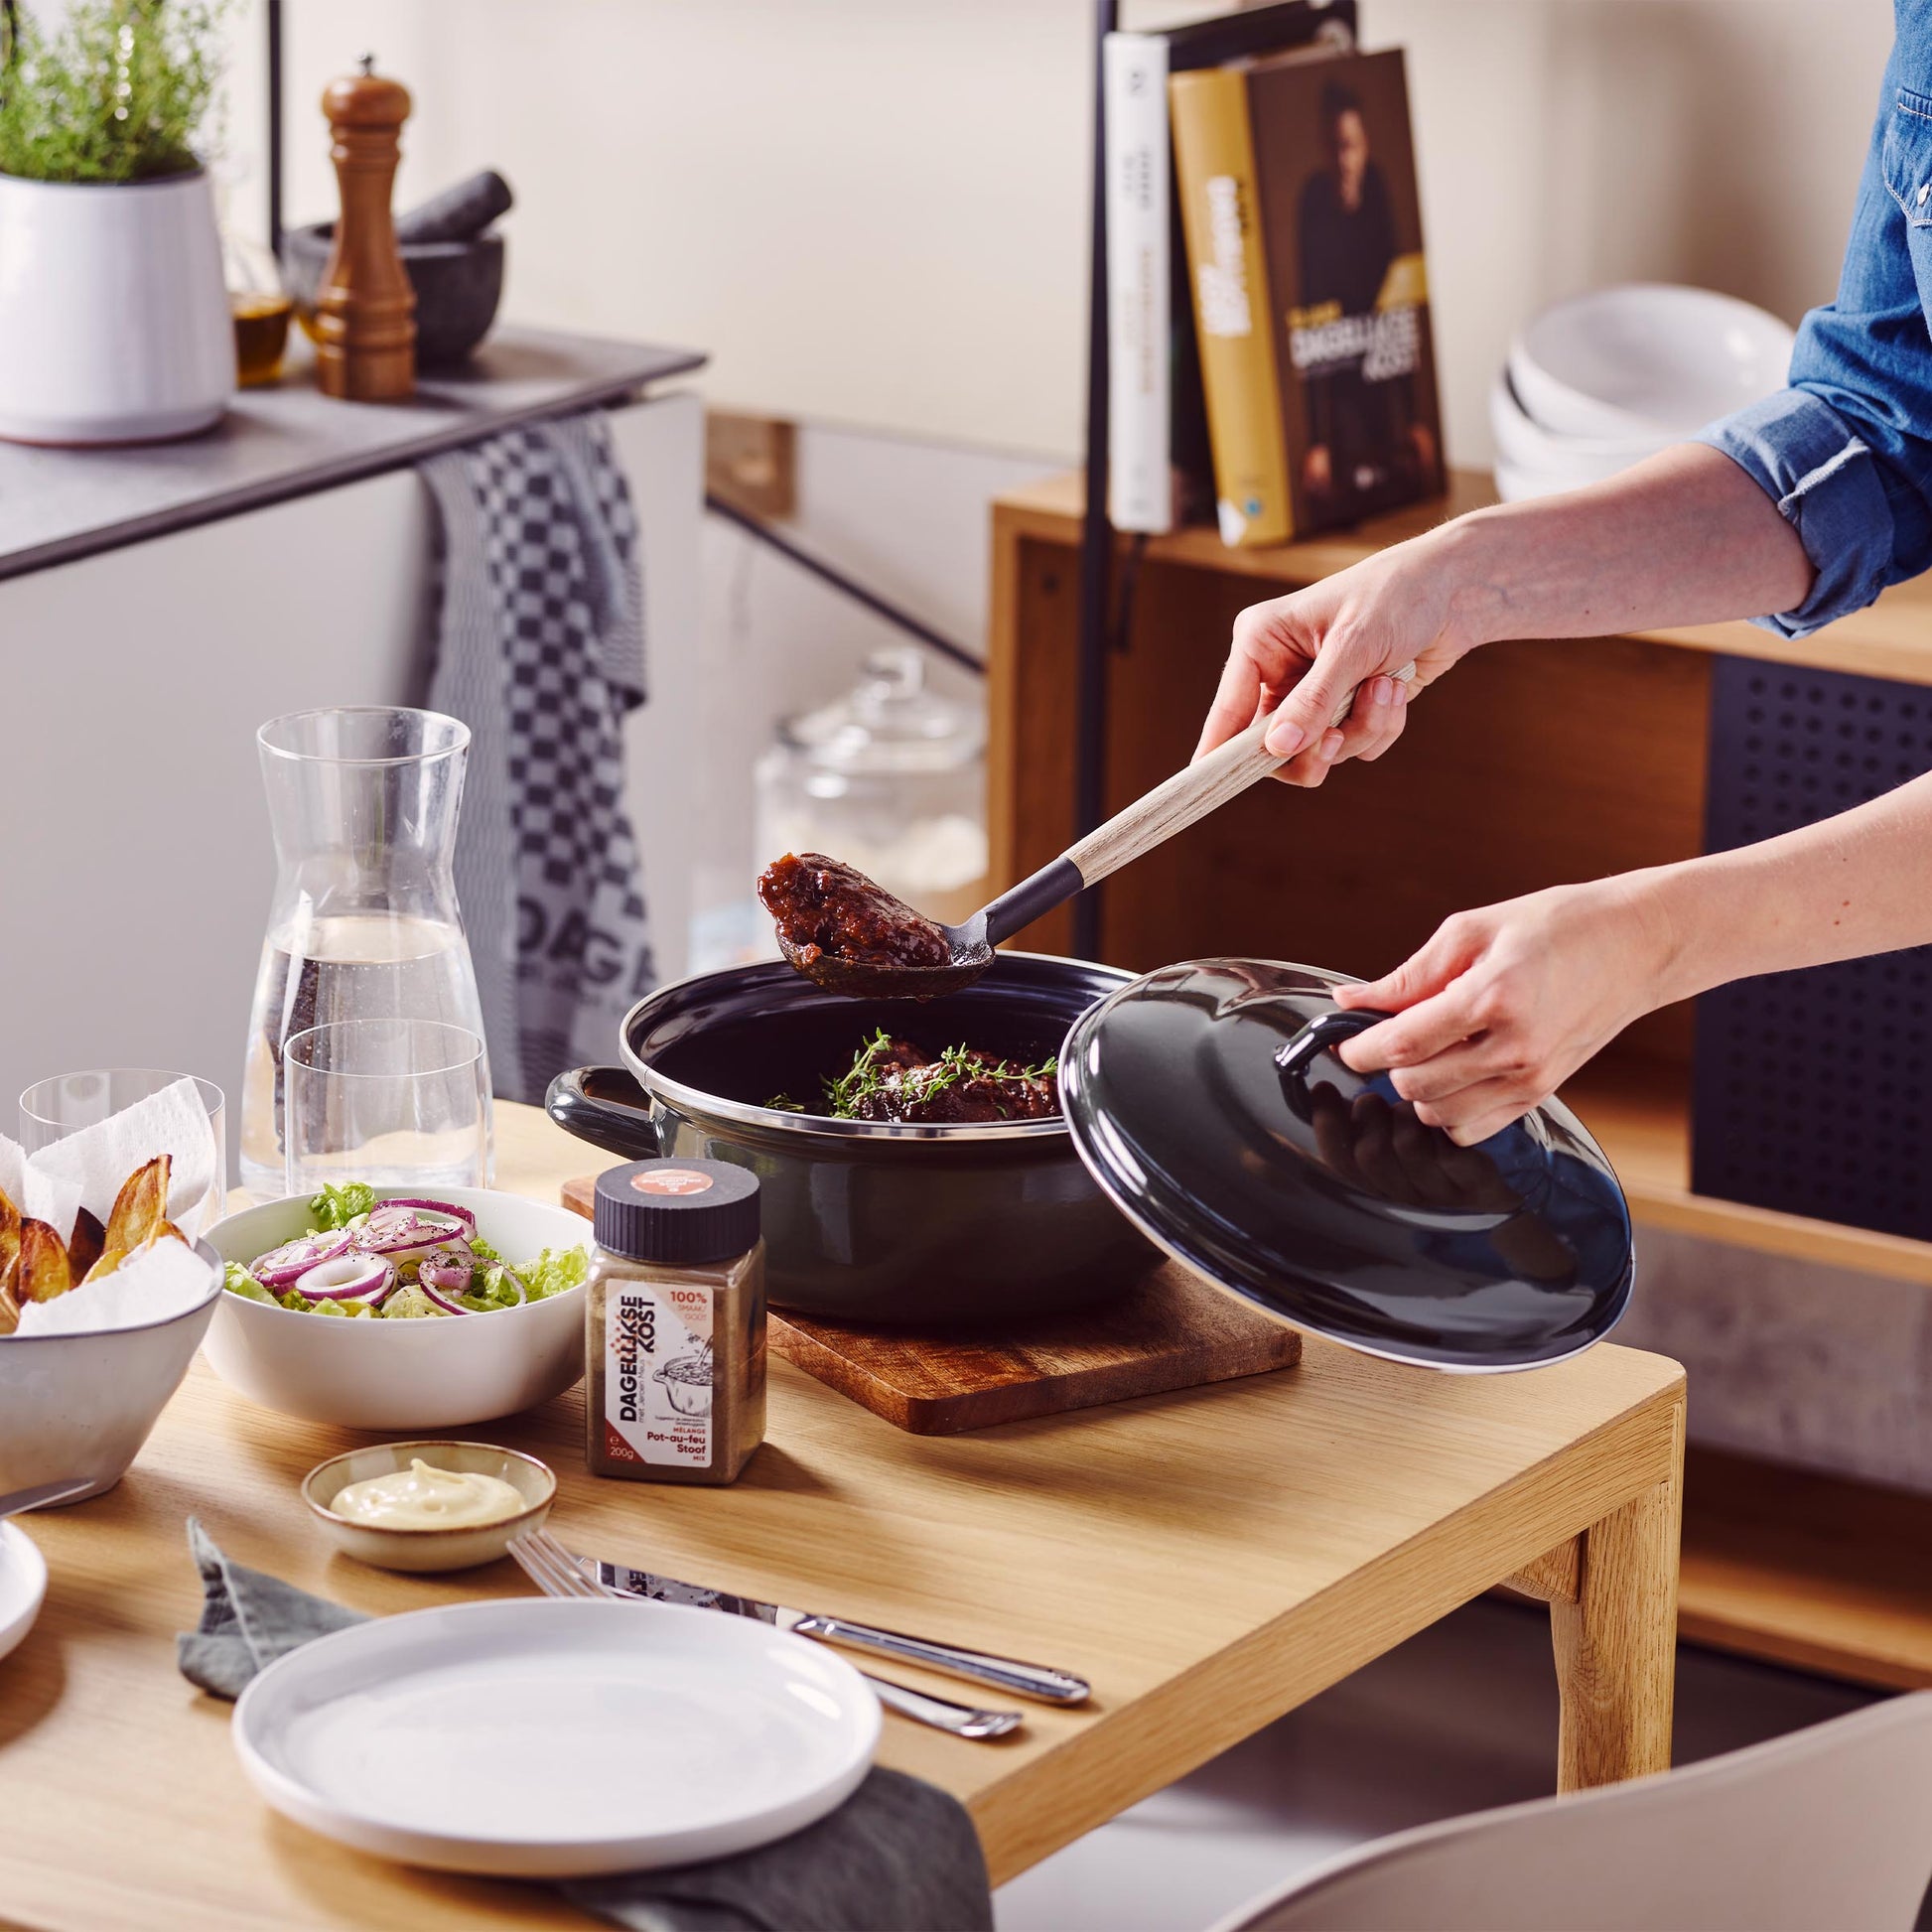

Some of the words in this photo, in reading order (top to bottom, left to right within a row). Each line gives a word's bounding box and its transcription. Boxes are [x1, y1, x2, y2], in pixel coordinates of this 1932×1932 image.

[670, 1291, 707, 1304] 100%
[637, 1297, 655, 1353] KOST
[620, 1296, 637, 1423] DAGELIJKSE
[647, 1432, 706, 1445] Pot-au-feu
[610, 1447, 634, 1460] 200g
[677, 1444, 706, 1454] Stoof
